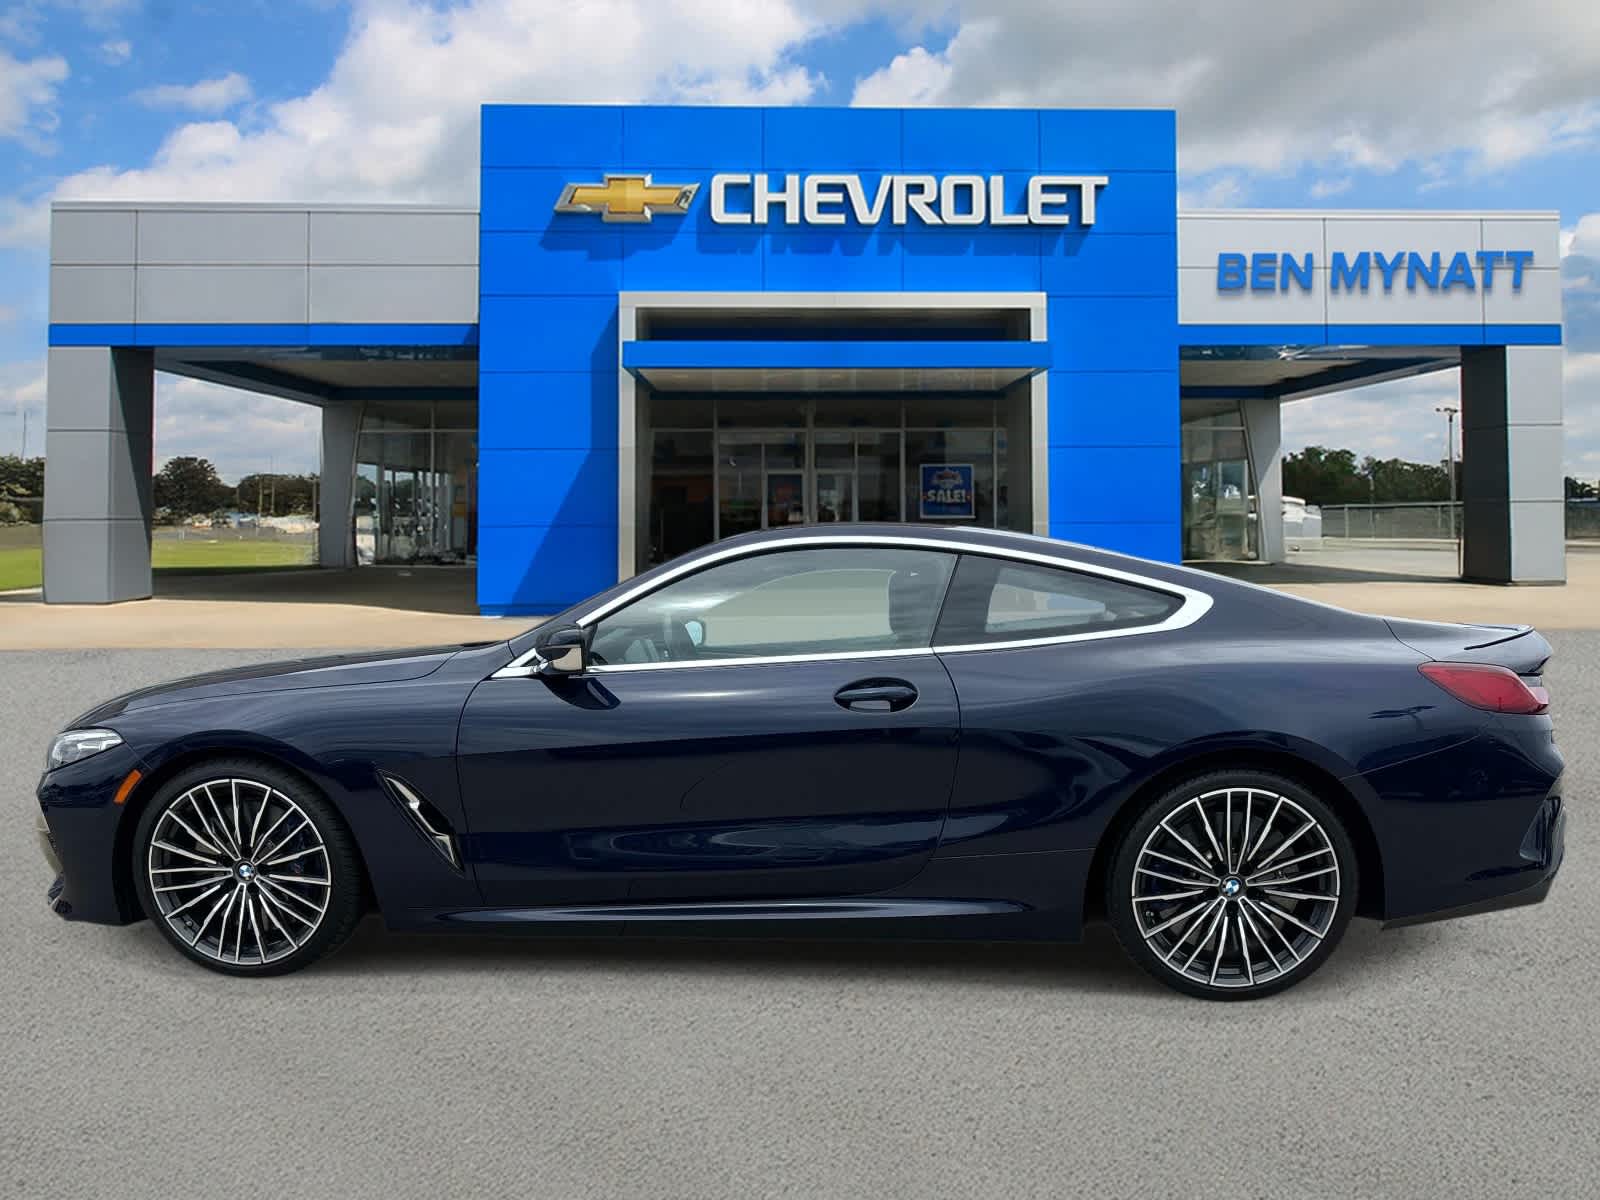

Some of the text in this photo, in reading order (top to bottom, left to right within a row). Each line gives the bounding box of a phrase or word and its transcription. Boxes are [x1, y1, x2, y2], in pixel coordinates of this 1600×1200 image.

[710, 173, 1109, 225] CHEVROLET
[1217, 250, 1534, 291] BEN MYNATT
